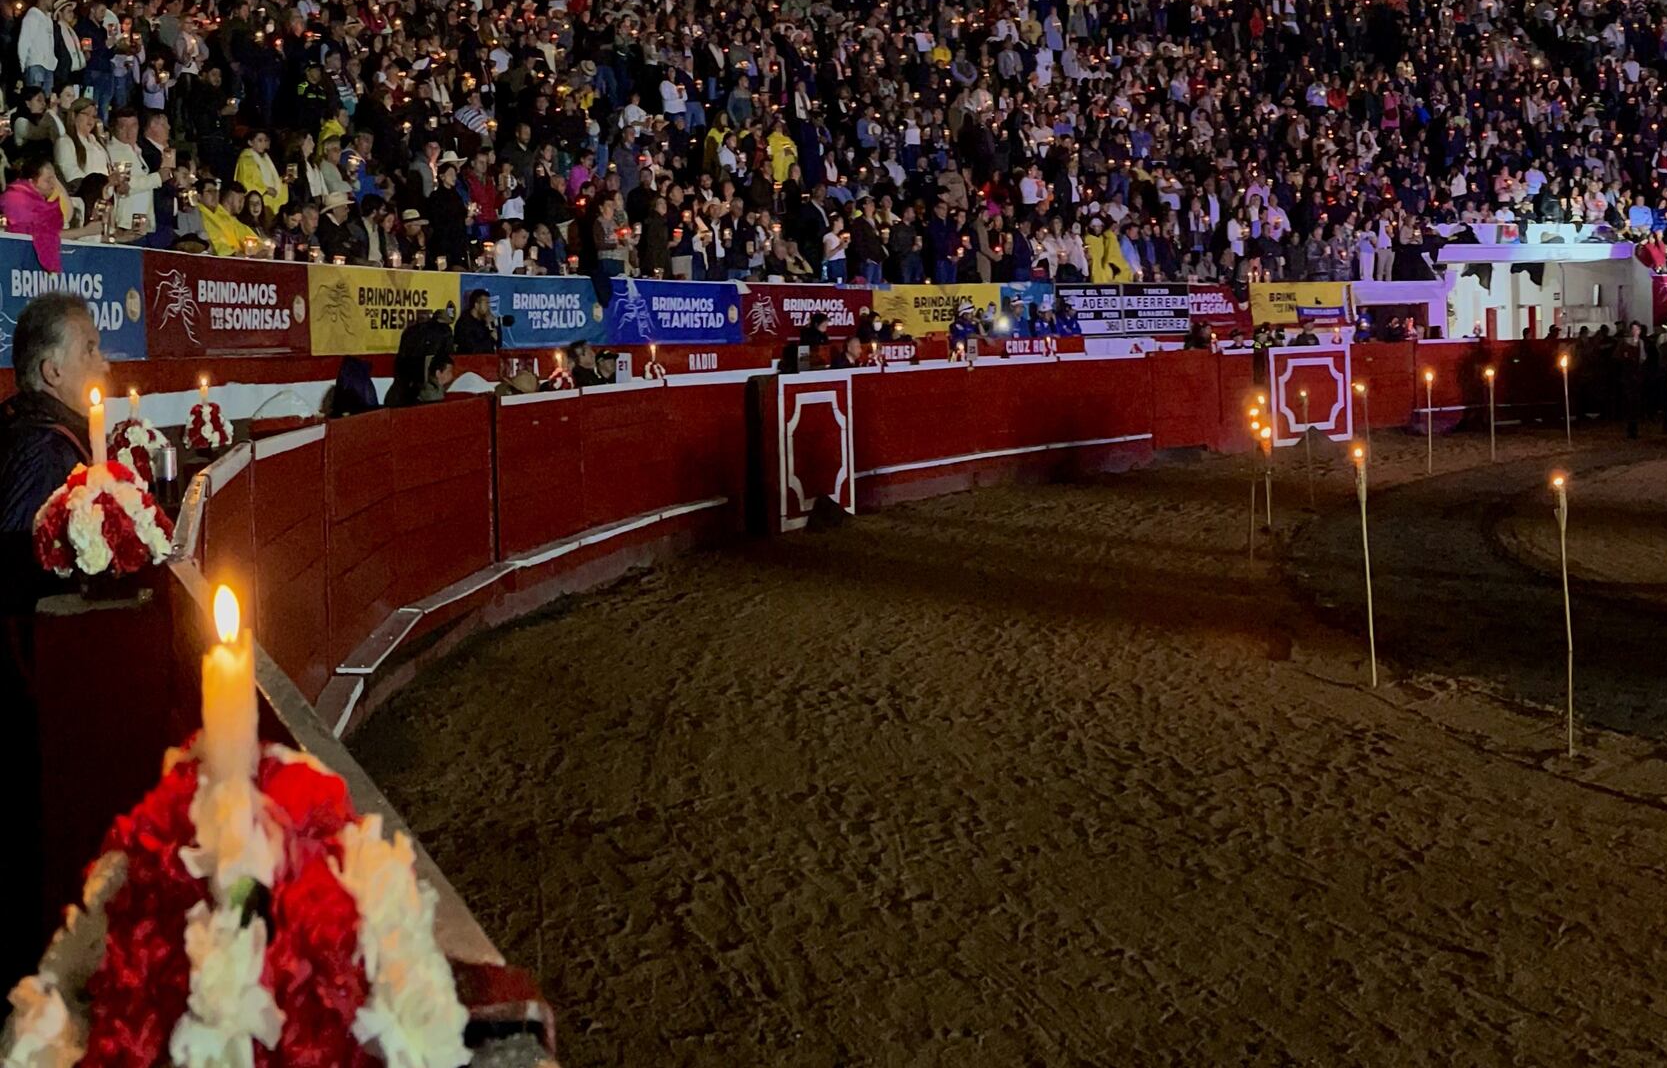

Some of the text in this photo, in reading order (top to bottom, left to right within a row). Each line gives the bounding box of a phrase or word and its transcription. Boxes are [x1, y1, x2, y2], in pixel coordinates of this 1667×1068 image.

[198, 279, 278, 306] BRINDAMOS
[358, 287, 428, 307] BRINDAMOS
[1189, 293, 1225, 303] DAMOS
[513, 293, 581, 310] BRINDAMOS
[652, 296, 714, 312] BRINDAMOS
[783, 298, 845, 312] BRINDAMOS
[1137, 297, 1186, 308] FERRERA
[225, 307, 291, 330] SONRISAS
[365, 308, 379, 318] POR
[528, 311, 541, 320] POR
[542, 310, 587, 329] SALUD
[671, 312, 725, 329] AMISTAD
[803, 308, 856, 327] AGRÍA
[1135, 319, 1188, 331] GUTIERREZ
[1005, 339, 1058, 354] CRUZ ROA
[689, 352, 718, 371] RADIO
